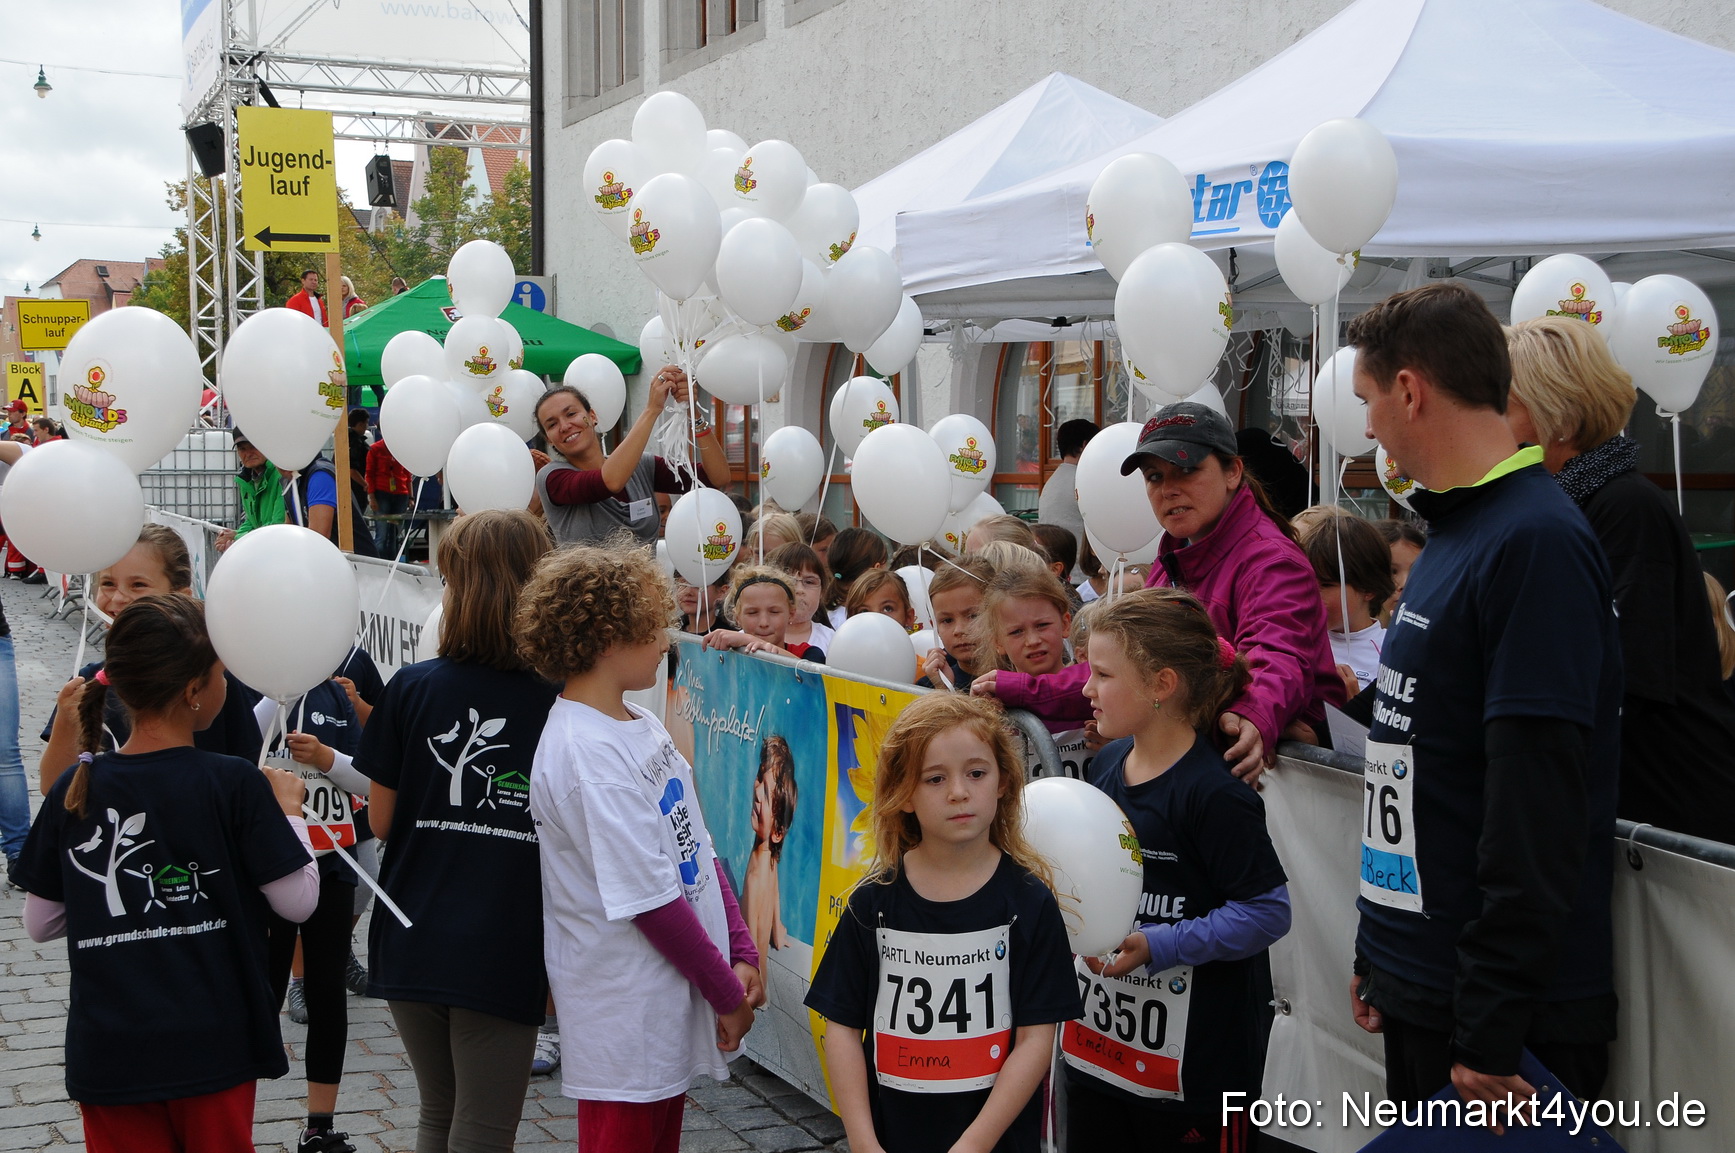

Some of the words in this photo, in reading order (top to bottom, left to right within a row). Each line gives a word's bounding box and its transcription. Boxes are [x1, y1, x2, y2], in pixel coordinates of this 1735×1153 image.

[244, 145, 332, 173] Jugend-
[270, 174, 310, 196] lauf
[1191, 174, 1252, 224] tar
[23, 314, 85, 326] Schnupper-
[45, 328, 65, 337] lauf
[11, 364, 41, 374] Block
[17, 378, 39, 404] A
[64, 393, 128, 423] PHYTOKIDS
[949, 453, 987, 469] PHYTOKIDS
[1364, 780, 1402, 845] 76
[416, 819, 539, 844] www.grundschule-neumarkt.
[1361, 848, 1416, 894] -Beck
[77, 918, 227, 949] www.grundschule-neumarkt.de
[882, 945, 911, 964] PARTL
[915, 948, 990, 966] Neumarkt
[887, 973, 995, 1035] 7341
[1078, 972, 1168, 1050] 7350
[898, 1046, 951, 1068] Emma
